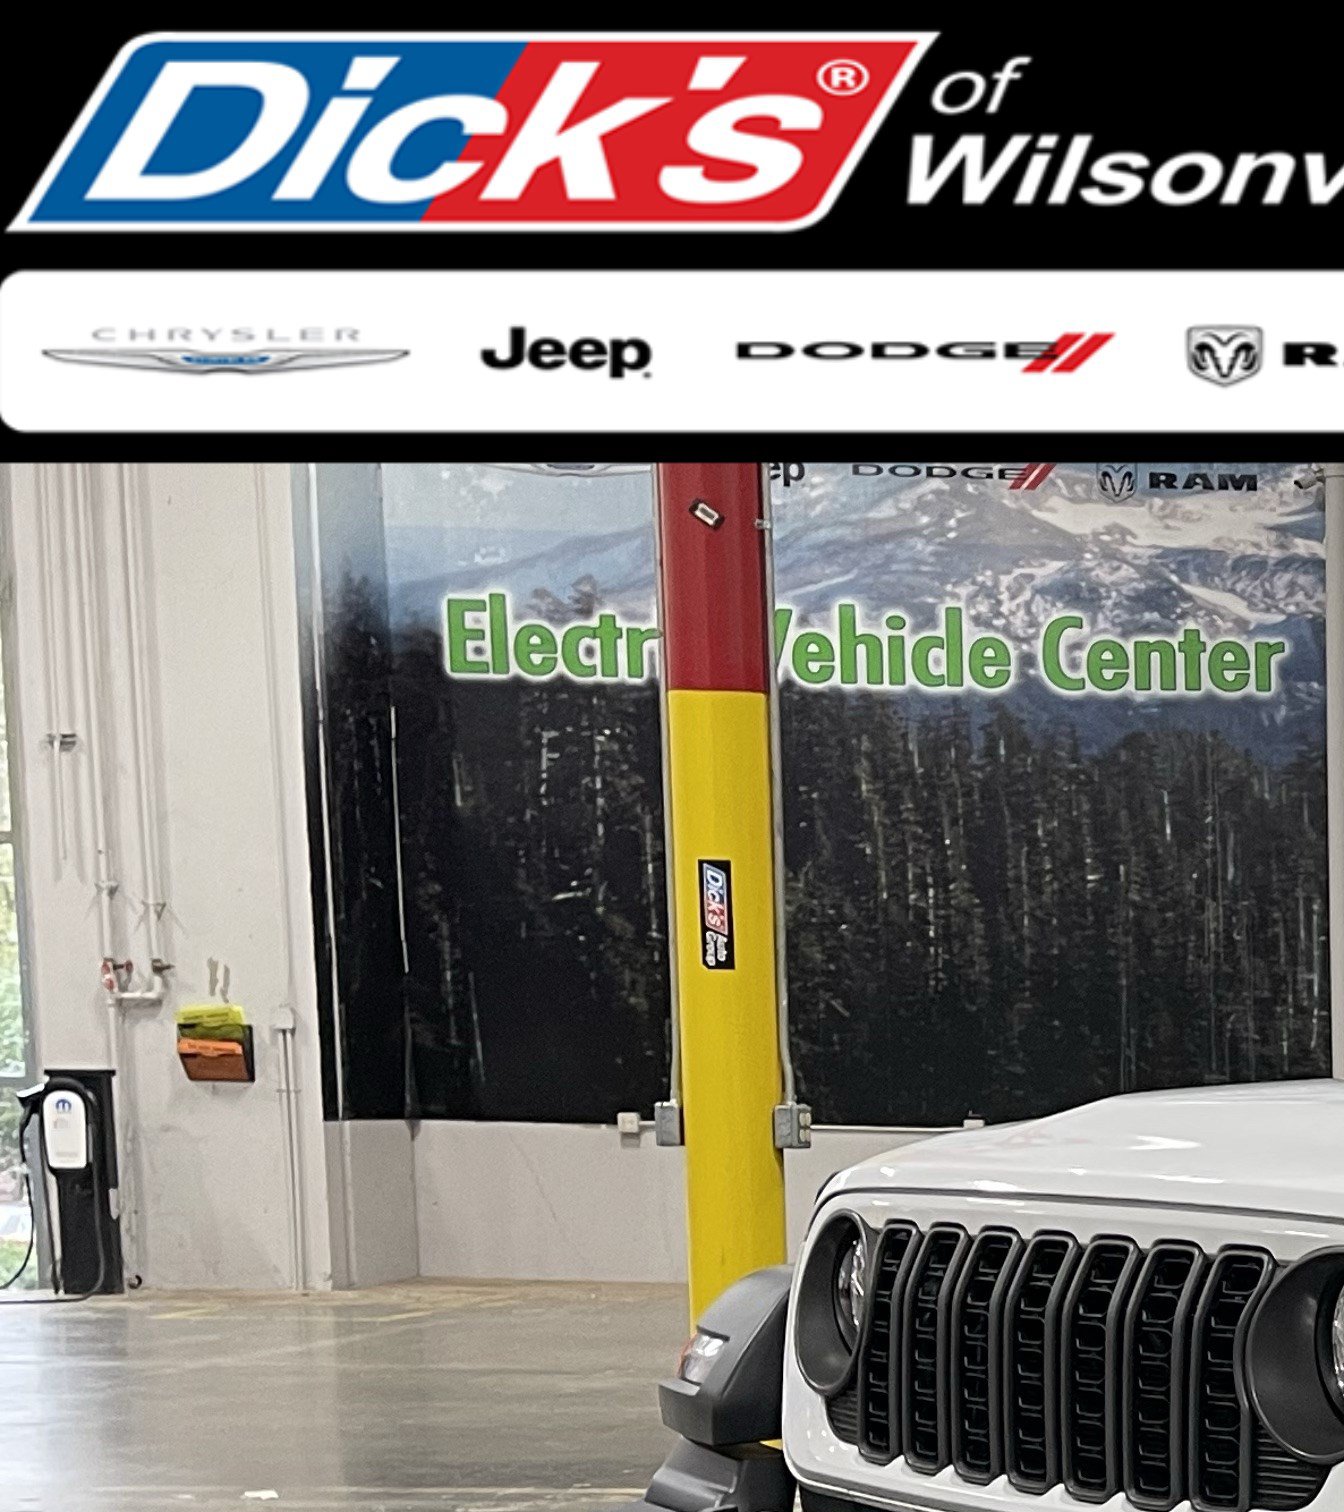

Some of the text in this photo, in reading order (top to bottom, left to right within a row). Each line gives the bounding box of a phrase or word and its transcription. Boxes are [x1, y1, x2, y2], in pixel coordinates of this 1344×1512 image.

[852, 463, 1028, 481] DODGE
[1149, 471, 1258, 492] RAM
[1042, 615, 1286, 692] Center
